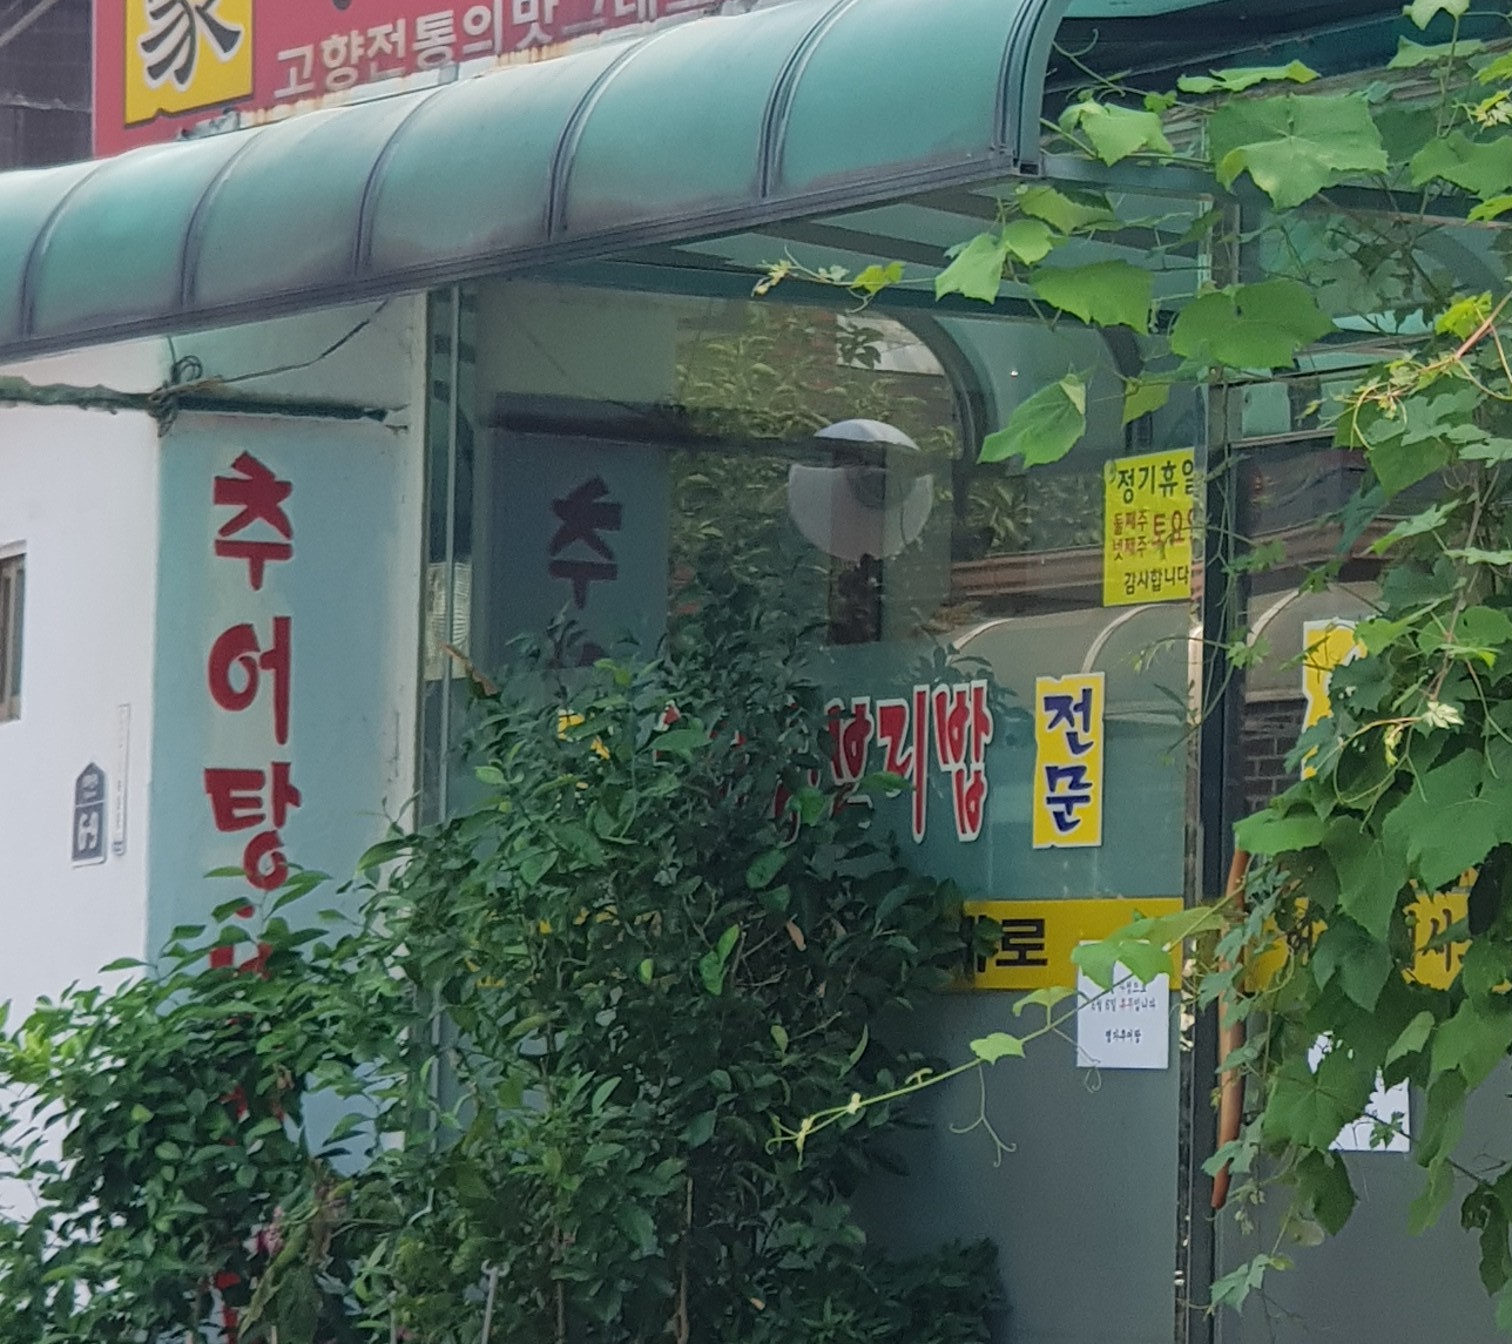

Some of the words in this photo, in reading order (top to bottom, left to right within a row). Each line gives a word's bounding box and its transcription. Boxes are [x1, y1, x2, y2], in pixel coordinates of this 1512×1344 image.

[1152, 508, 1194, 547] 토요
[1124, 565, 1190, 596] 감사합니다
[1043, 687, 1095, 833] 전문
